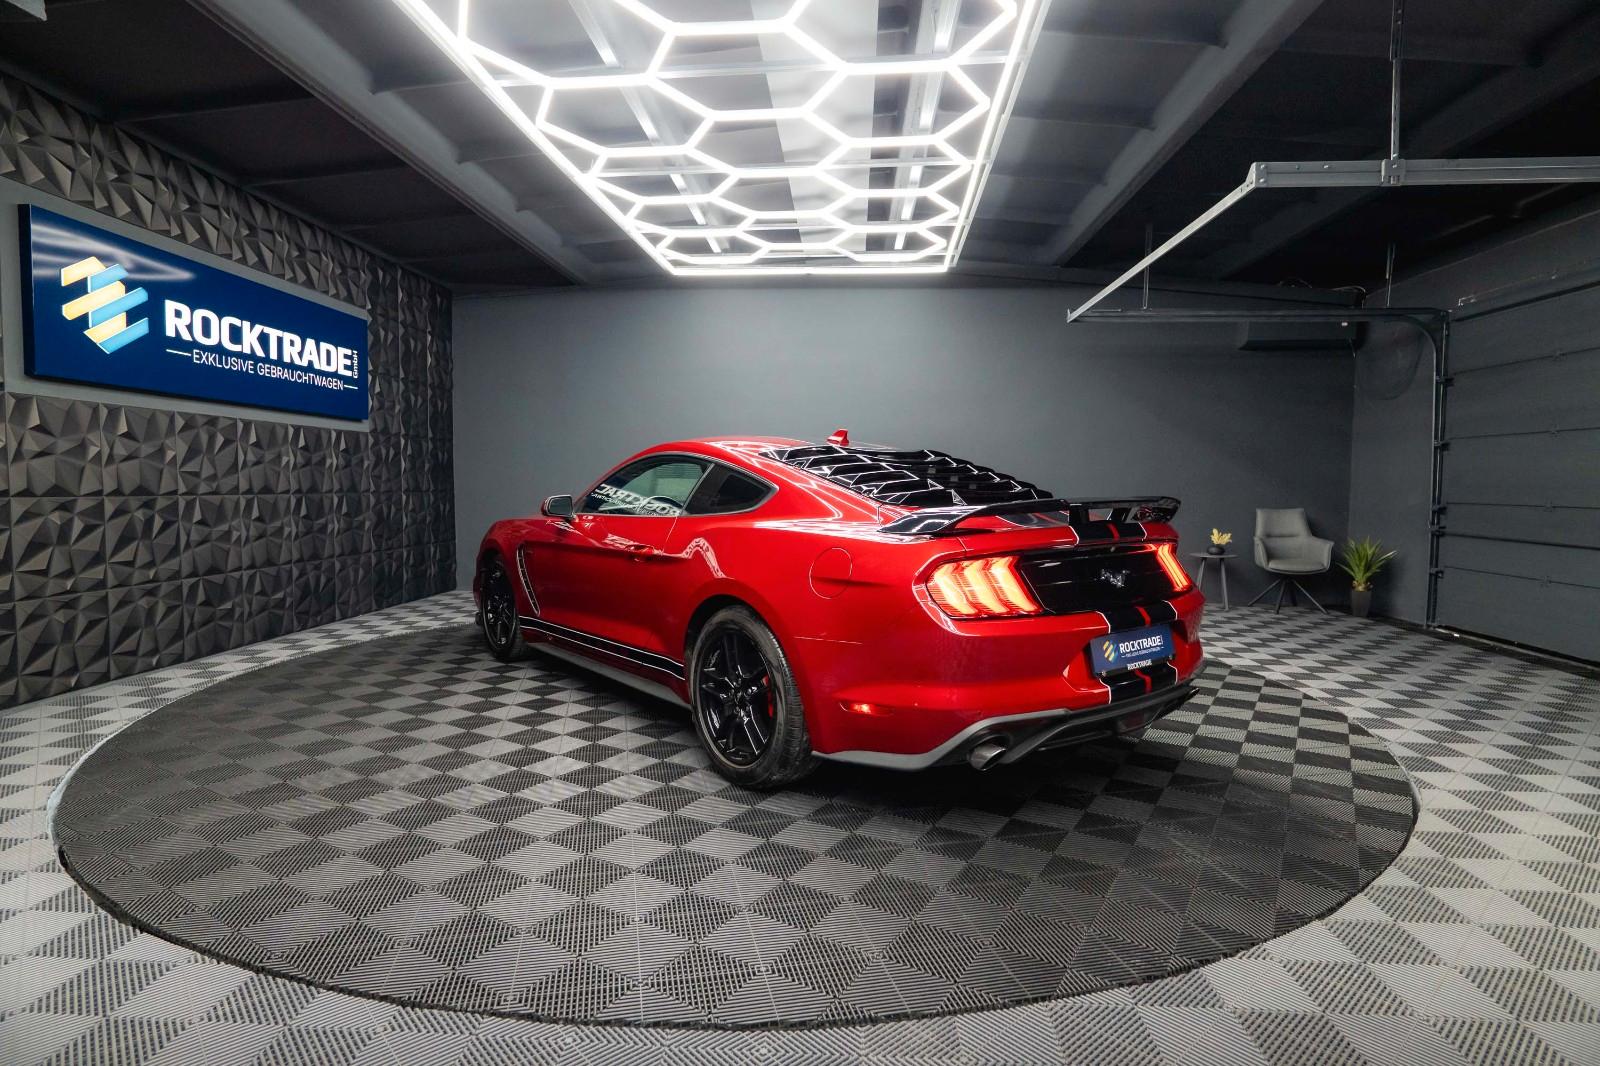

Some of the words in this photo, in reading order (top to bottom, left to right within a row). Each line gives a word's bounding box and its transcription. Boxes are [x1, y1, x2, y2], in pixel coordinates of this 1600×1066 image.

[165, 299, 353, 377] ROCKTRADE
[193, 349, 255, 374] EXKLUSIVE
[257, 362, 344, 391] GEBRAUCHTWAGEN
[1119, 635, 1161, 653] ROCKTRADE
[1126, 659, 1152, 670] ROCKTRADE
